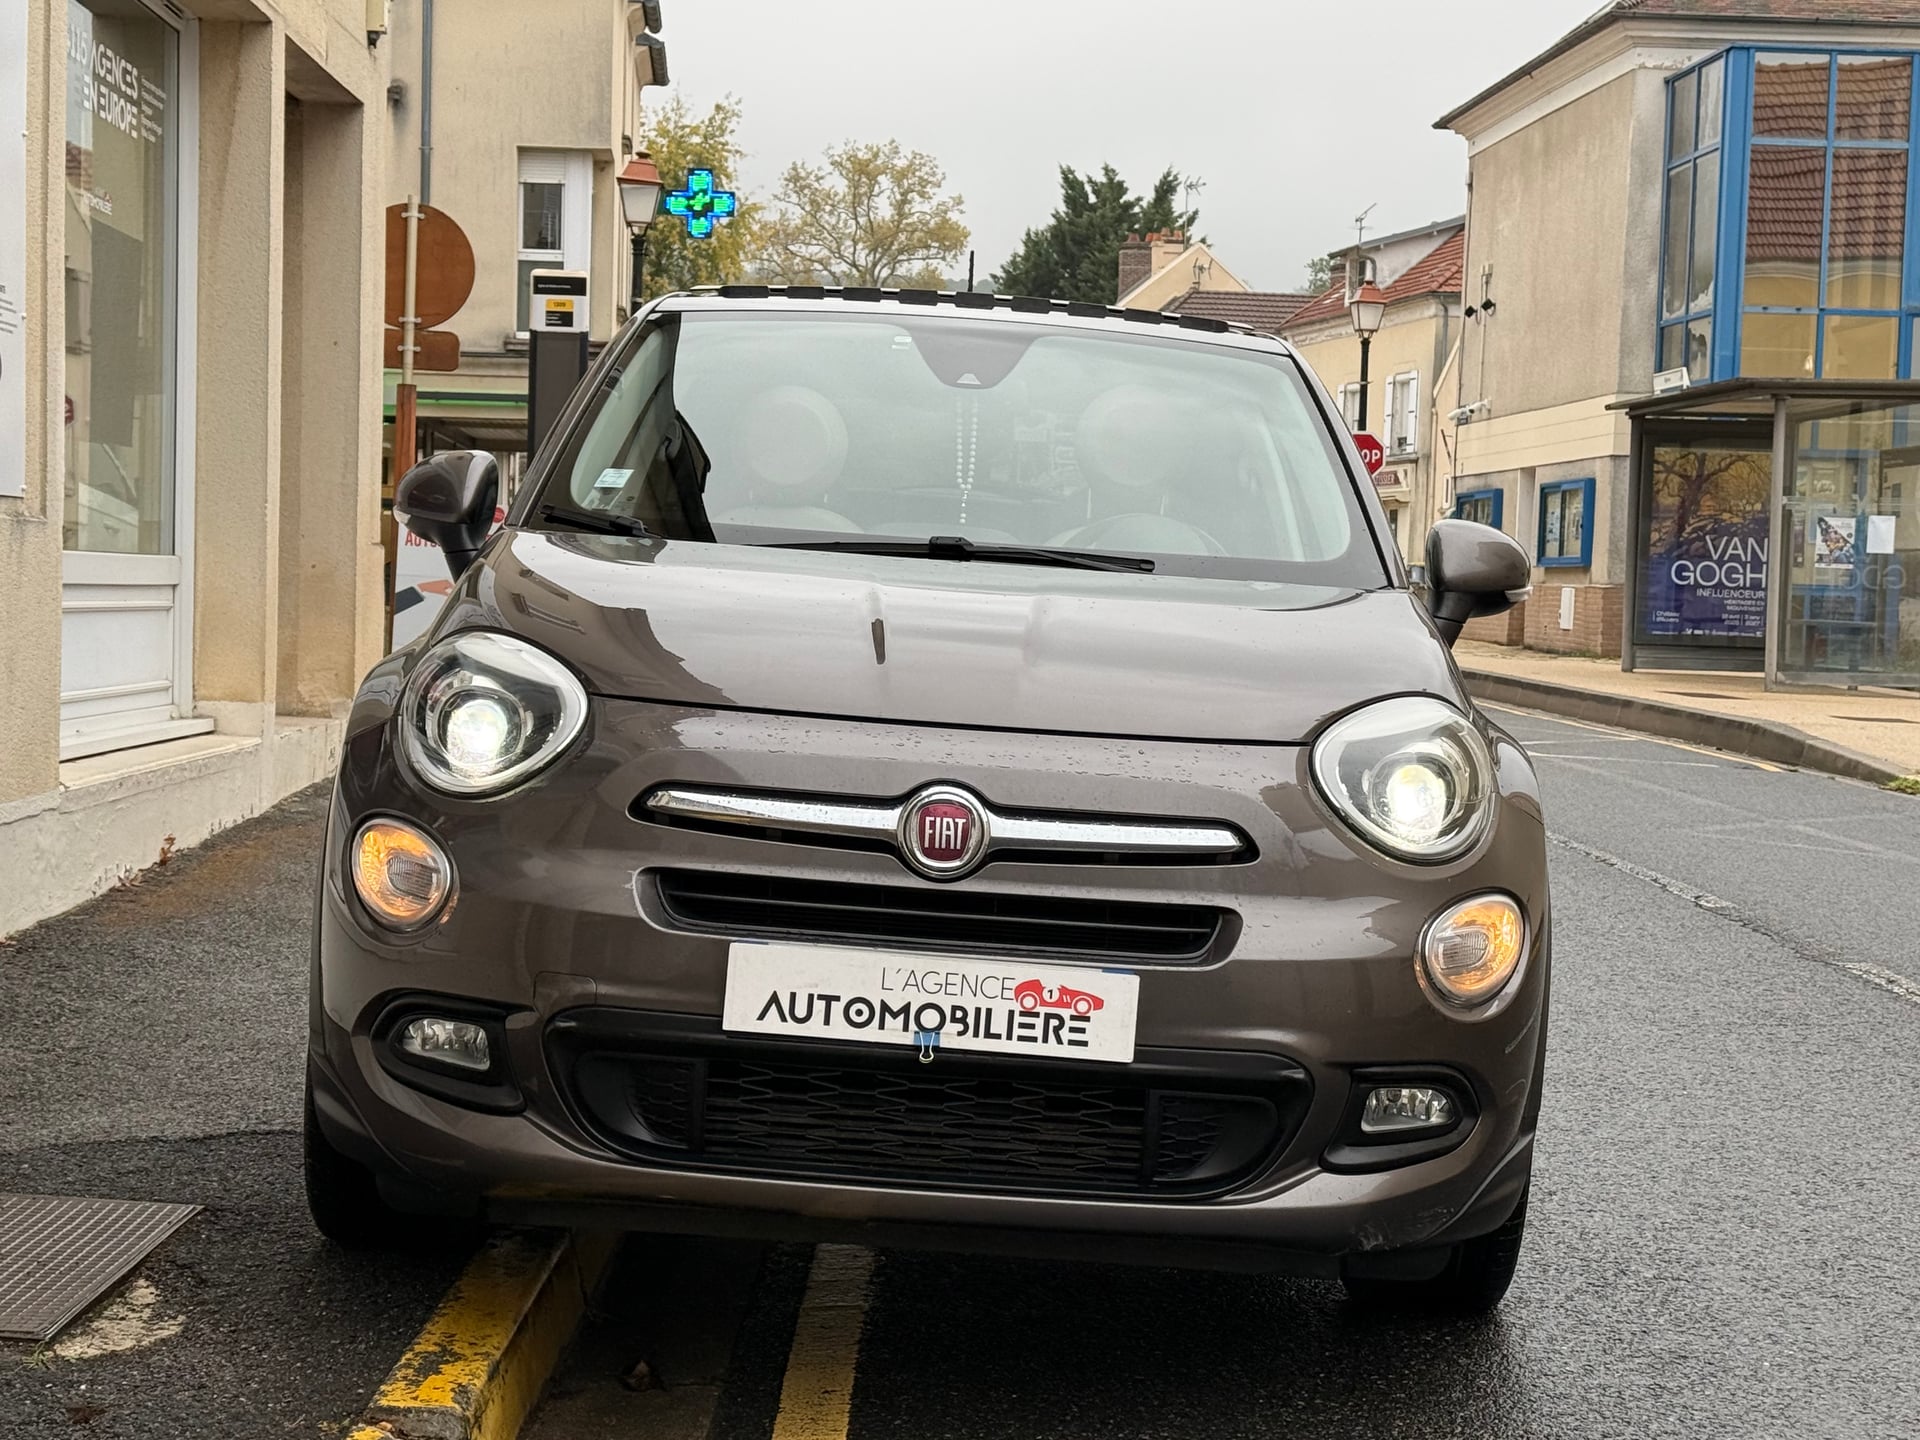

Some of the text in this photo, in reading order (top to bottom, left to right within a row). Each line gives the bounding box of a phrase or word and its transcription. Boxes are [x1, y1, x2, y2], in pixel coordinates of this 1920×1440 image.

[90, 40, 138, 100] AGENCES
[83, 73, 98, 113] EN
[99, 84, 138, 140] EUROPE
[1361, 448, 1381, 464] OP
[1705, 535, 1769, 562] VAN
[1670, 559, 1767, 588] GOGH
[1696, 588, 1766, 599] INFLUENCEUR
[923, 815, 967, 851] FIAT
[880, 966, 1017, 1001] L'AGENCE
[756, 989, 1092, 1048] AUTOMOBILIERE
